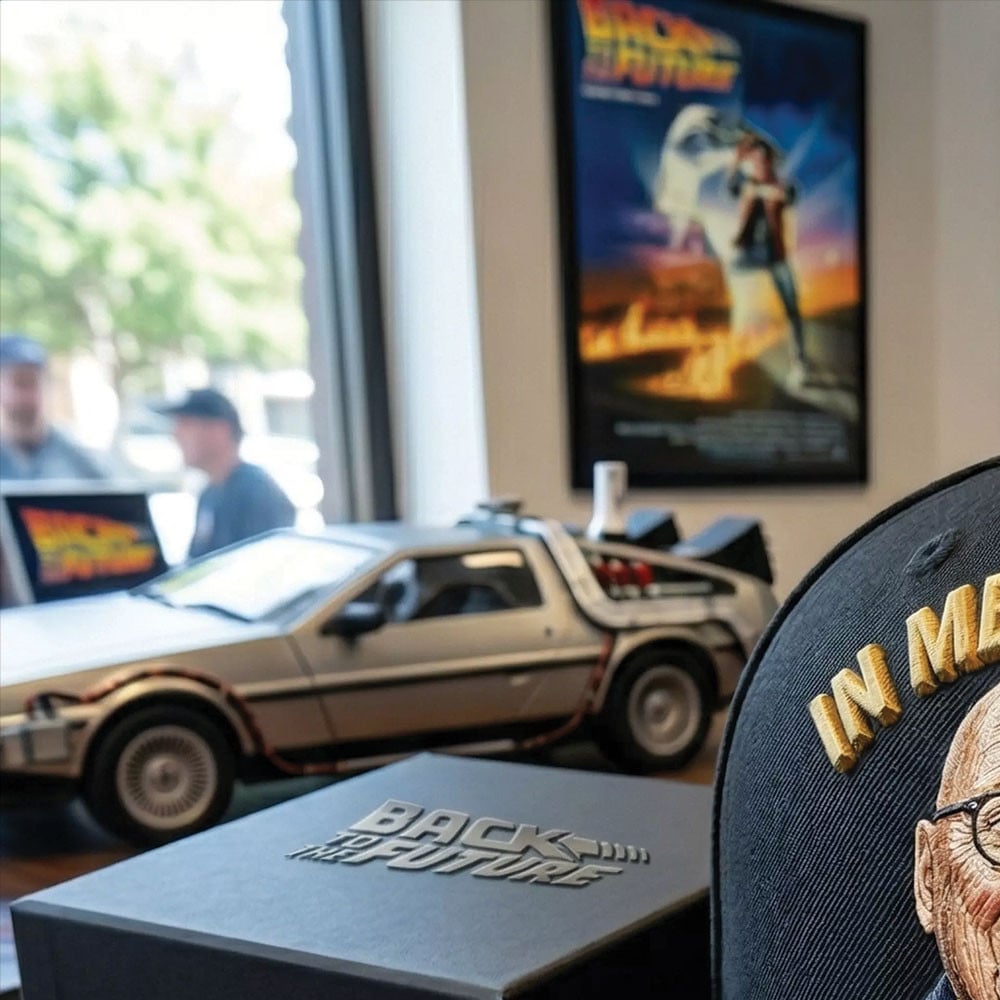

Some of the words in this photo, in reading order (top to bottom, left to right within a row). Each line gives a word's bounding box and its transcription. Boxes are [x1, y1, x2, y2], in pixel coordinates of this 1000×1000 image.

[809, 643, 902, 774] IN
[325, 831, 383, 850] TO
[349, 799, 578, 862] BACK
[284, 844, 360, 863] THE
[340, 839, 623, 887] FUTURE
